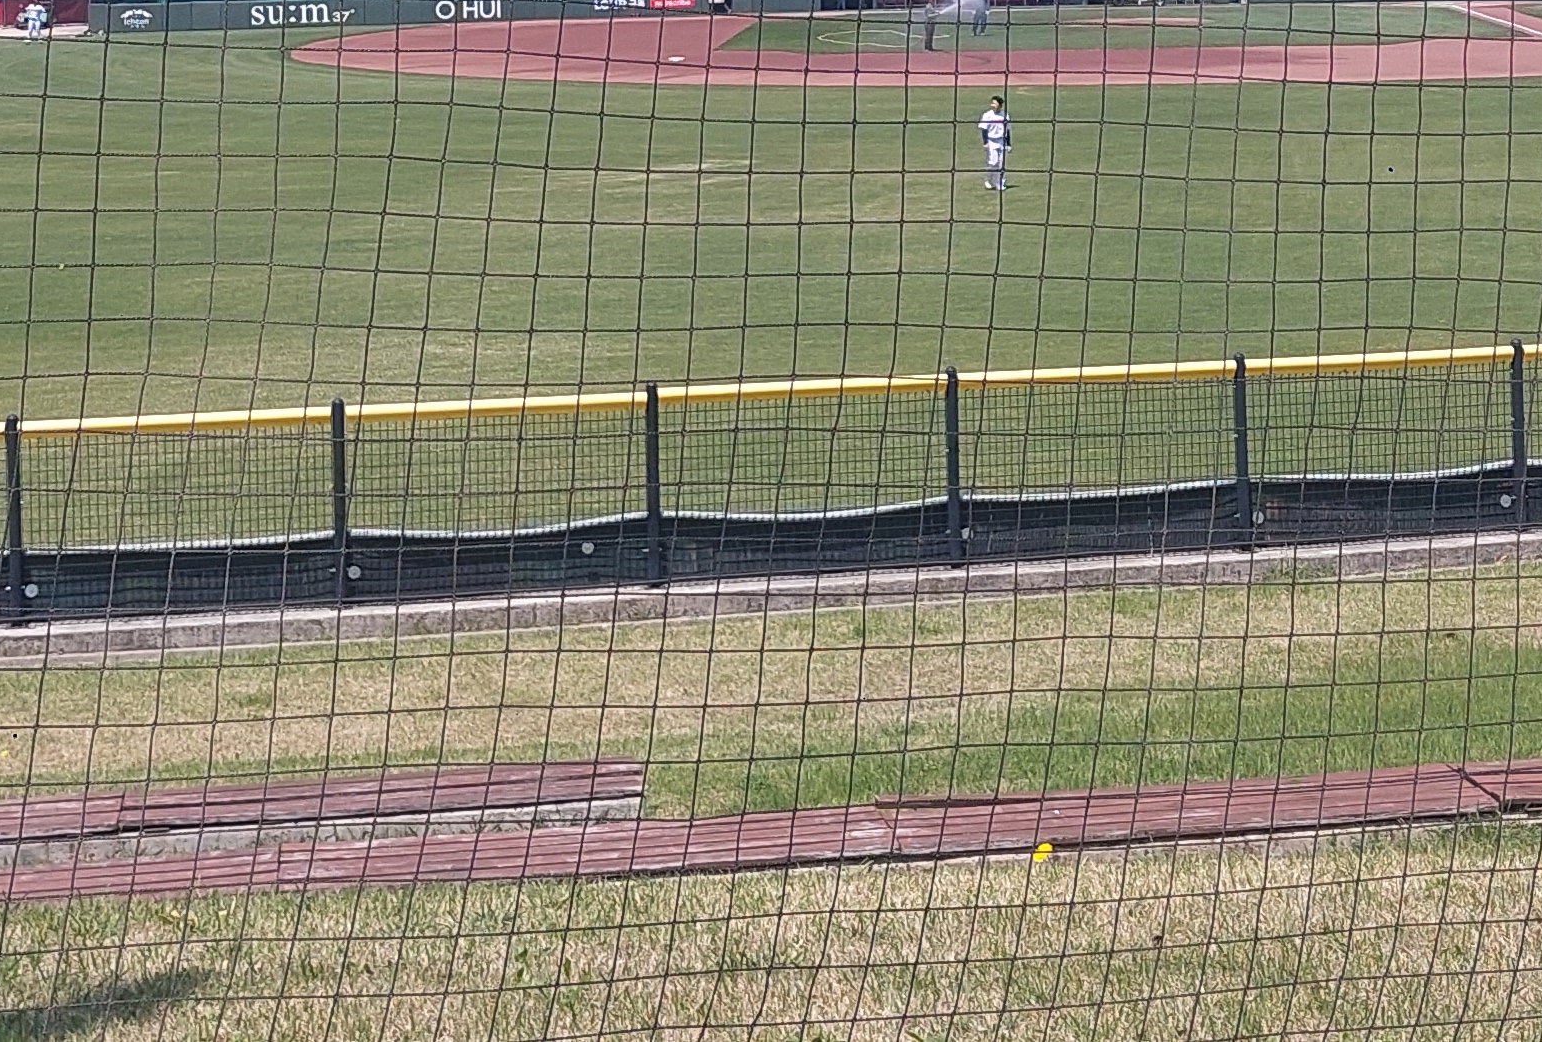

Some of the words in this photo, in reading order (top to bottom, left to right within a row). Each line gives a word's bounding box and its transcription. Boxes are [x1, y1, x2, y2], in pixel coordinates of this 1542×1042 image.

[251, 3, 330, 26] su:m
[435, 0, 457, 20] O
[462, 0, 502, 19] HUI
